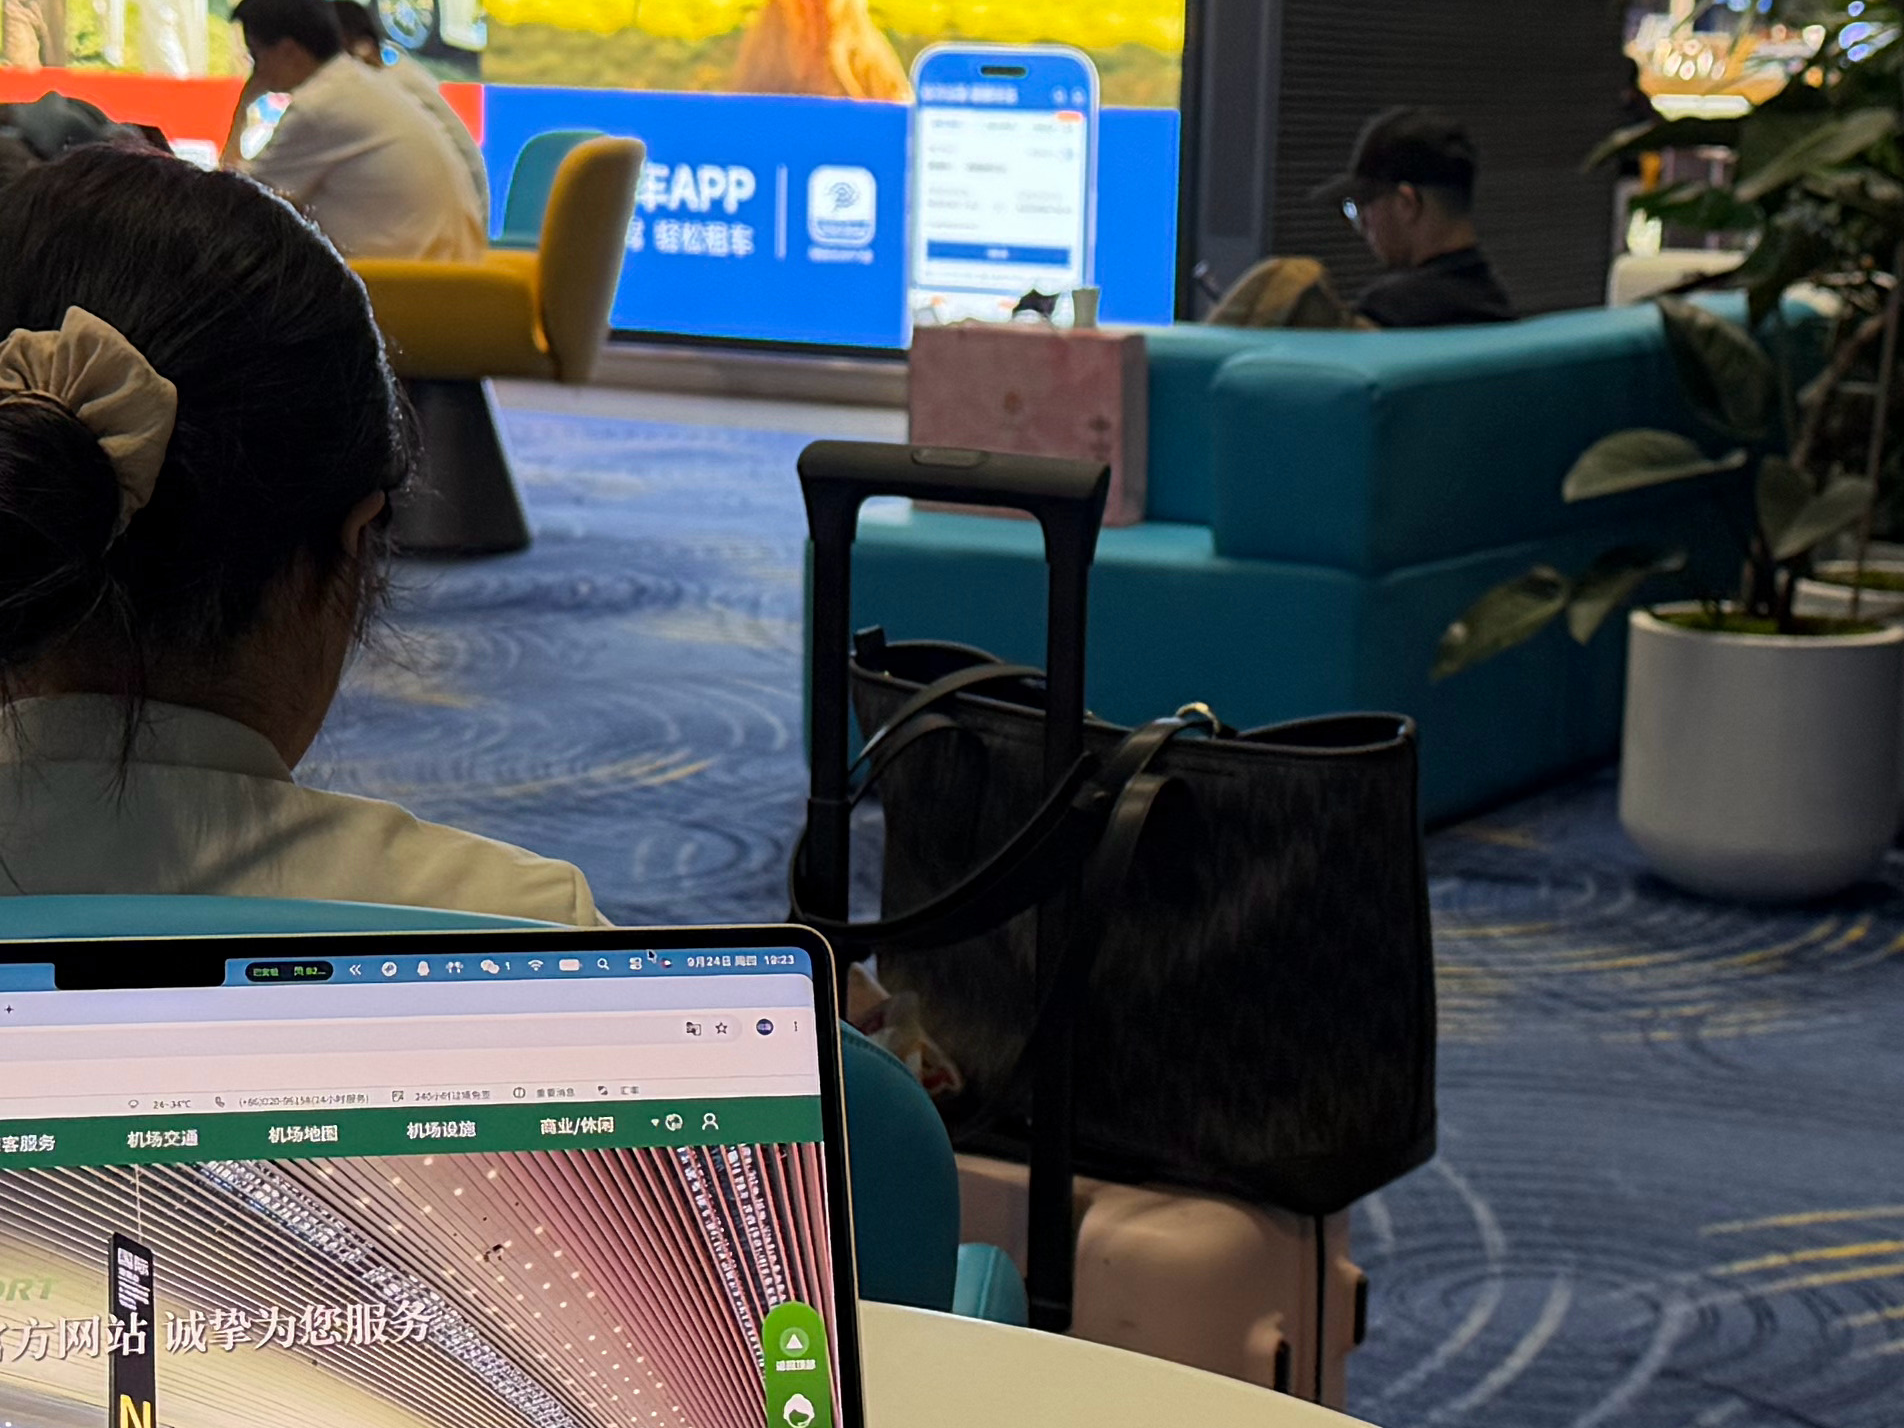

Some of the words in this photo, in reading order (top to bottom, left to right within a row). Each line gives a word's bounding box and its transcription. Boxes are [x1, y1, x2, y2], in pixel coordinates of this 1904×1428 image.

[268, 1124, 339, 1144] 机场地图
[406, 1120, 477, 1139] 机场设施
[540, 1116, 615, 1136] 商业/休闲
[127, 1129, 199, 1149] 机场交通
[164, 1300, 431, 1352] 诚挚为您服务
